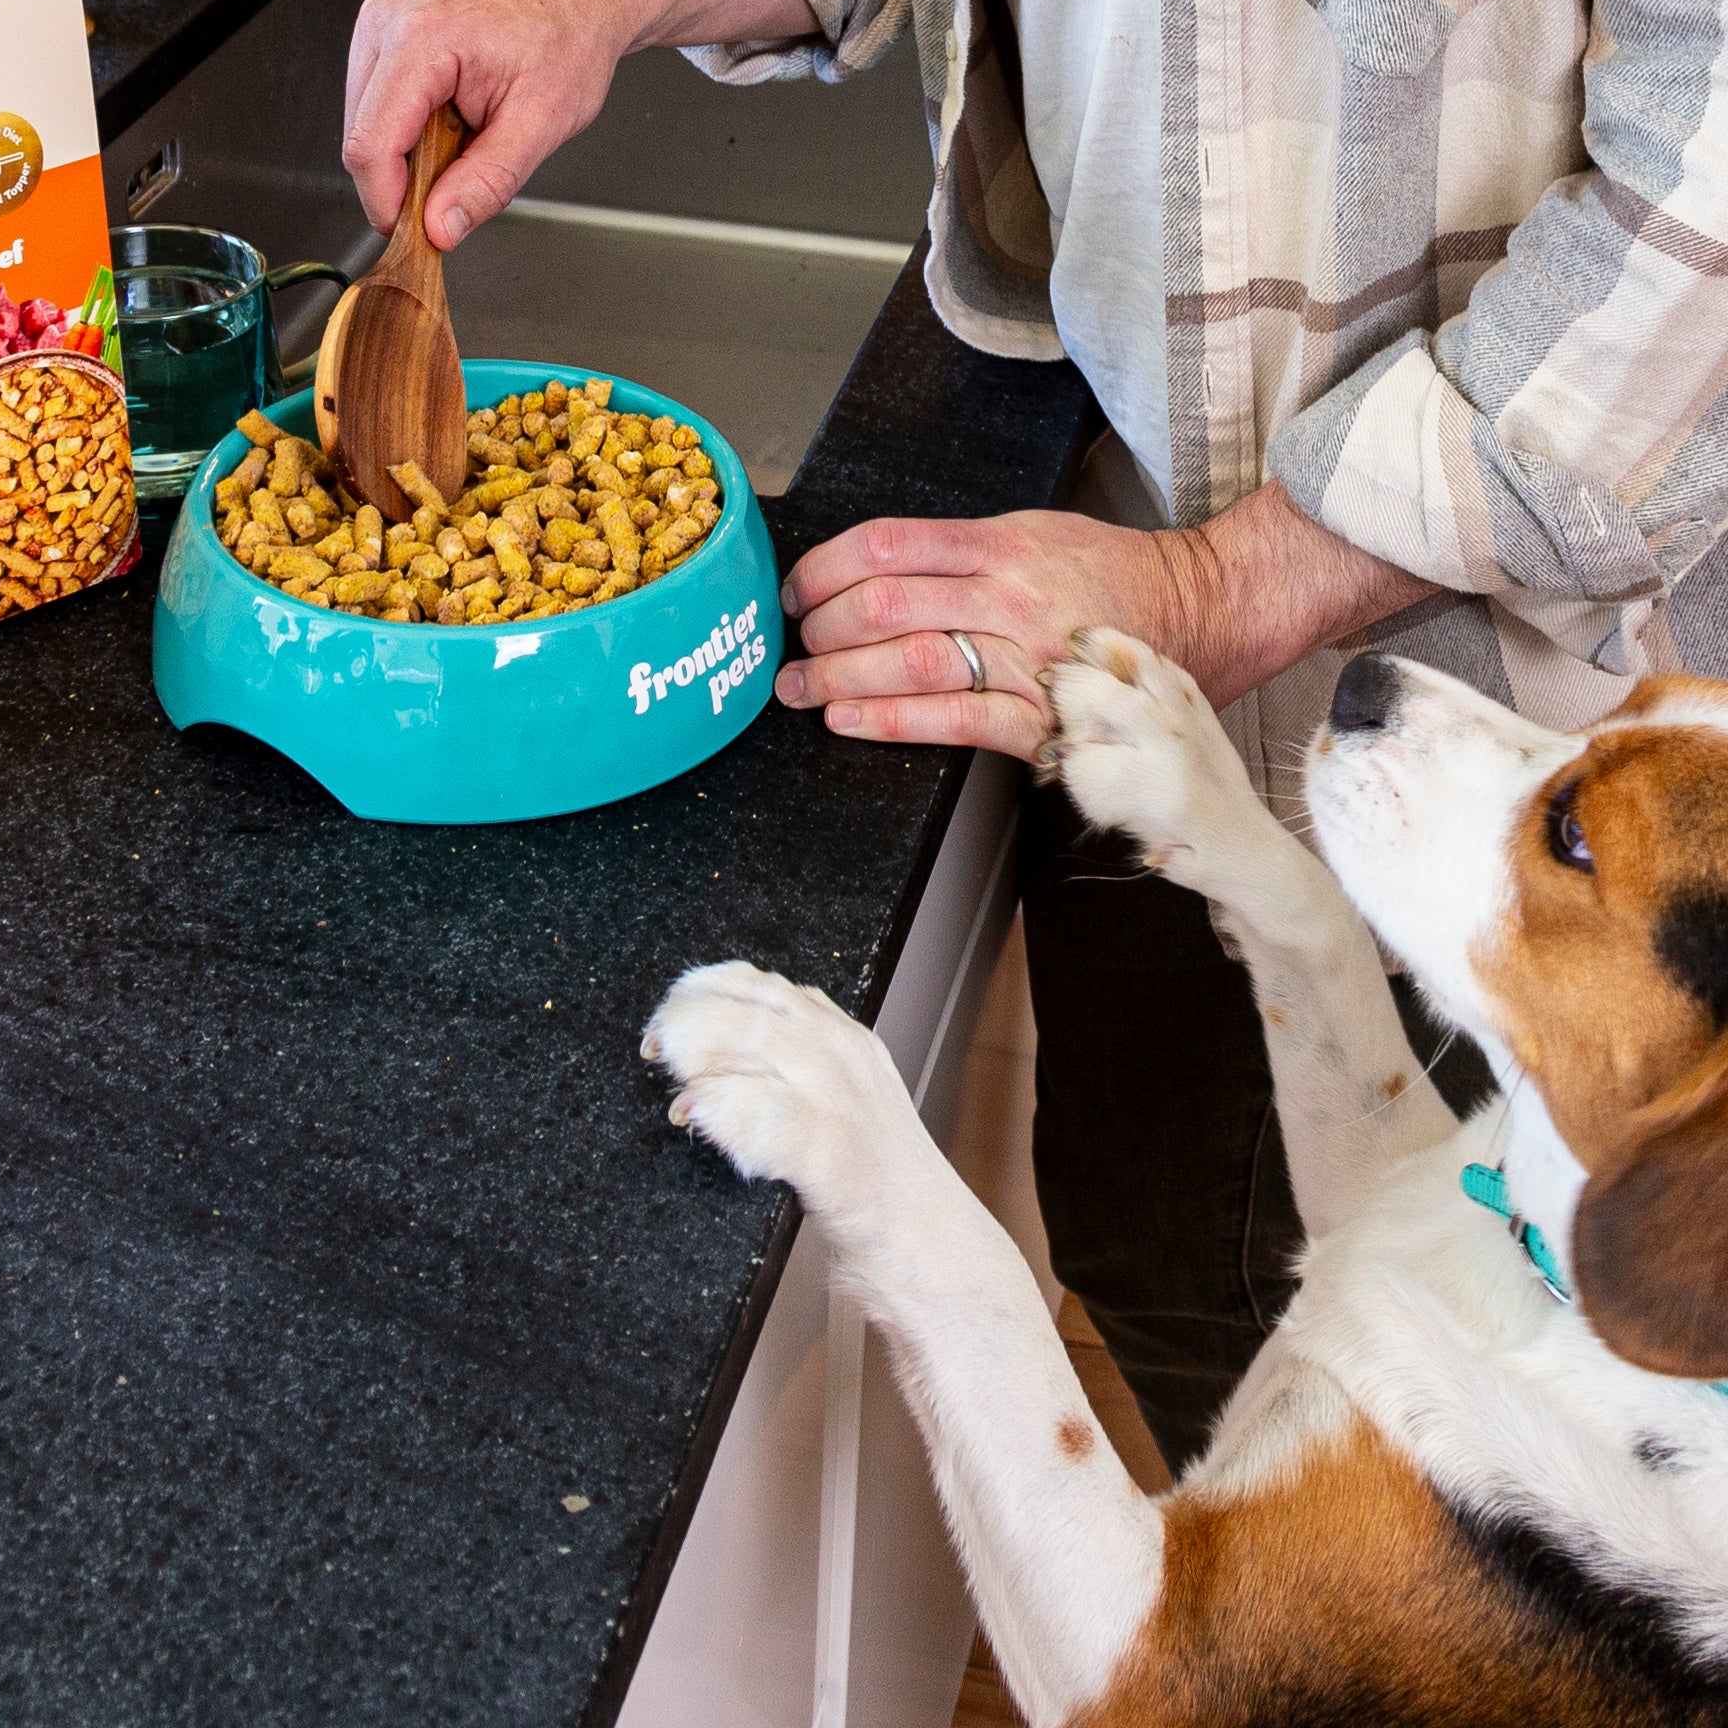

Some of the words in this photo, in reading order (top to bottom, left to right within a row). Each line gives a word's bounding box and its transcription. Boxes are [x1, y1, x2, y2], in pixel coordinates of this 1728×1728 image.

[2, 126, 24, 146] Diet
[3, 162, 31, 200] Topper
[627, 600, 758, 715] frontier
[708, 634, 767, 715] pets
